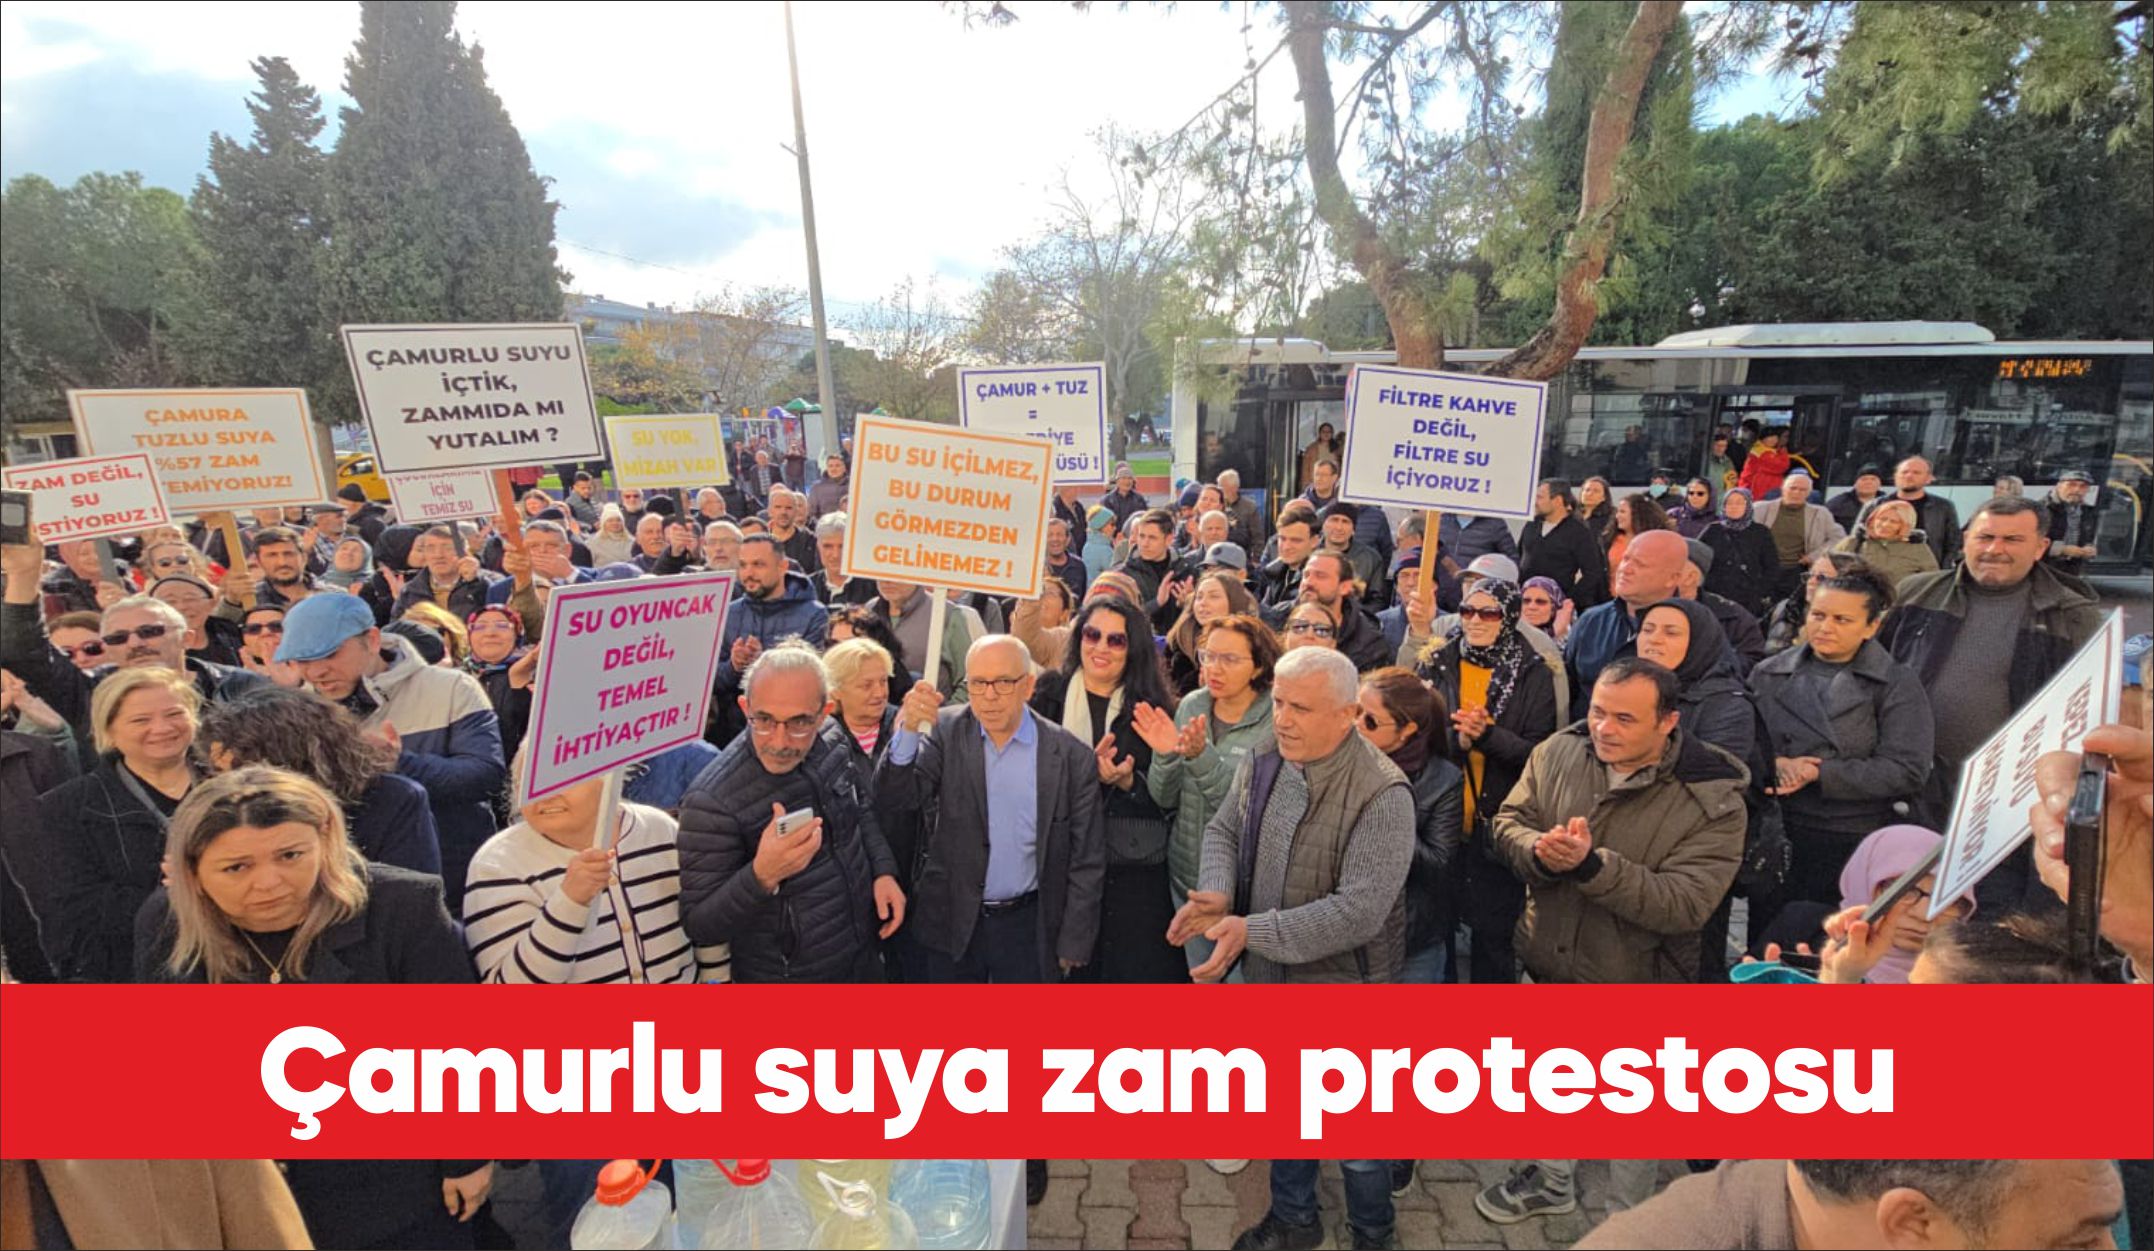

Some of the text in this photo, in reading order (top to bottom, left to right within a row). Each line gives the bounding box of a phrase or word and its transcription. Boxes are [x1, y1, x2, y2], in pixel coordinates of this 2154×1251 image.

[366, 345, 571, 371] ÇAMURLU SUYU
[441, 370, 518, 396] İÇTİK,
[976, 382, 1037, 402] ÇAMUR
[1055, 380, 1088, 395] TUZ
[401, 400, 565, 424] ZAMMIDA MI
[1378, 385, 1517, 416] FİLTRE KAHVE
[145, 408, 248, 427] ÇAMURA
[133, 430, 277, 448] TUZLU SUYA
[427, 427, 559, 450] YUTALIM ?
[632, 429, 655, 446] SU
[1413, 418, 1476, 442] DEĞİL,
[155, 454, 261, 471] %57 ZAM
[683, 458, 716, 473] VAR
[867, 441, 1039, 484] BU SU İÇİLMEZ,
[1093, 456, 1098, 470] !
[1393, 440, 1490, 467] FİLTRE SU
[71, 464, 143, 485] DEĞİL,
[162, 475, 292, 494] EMİYORUZ!
[1386, 465, 1491, 494] İÇİYORUZ !
[71, 493, 100, 507] SU
[421, 498, 473, 515] TEMİZ SU
[888, 478, 1012, 512] BU DURUM
[152, 506, 159, 518] !
[874, 508, 1018, 546] GÖRMEZDEN
[873, 543, 1013, 578] GELİNEMEZ !
[567, 593, 716, 637] SU OYUNCAK
[603, 632, 675, 671] DEĞİL,
[598, 675, 668, 711] TEMEL
[553, 703, 691, 766] İHTİYAÇTIR !
